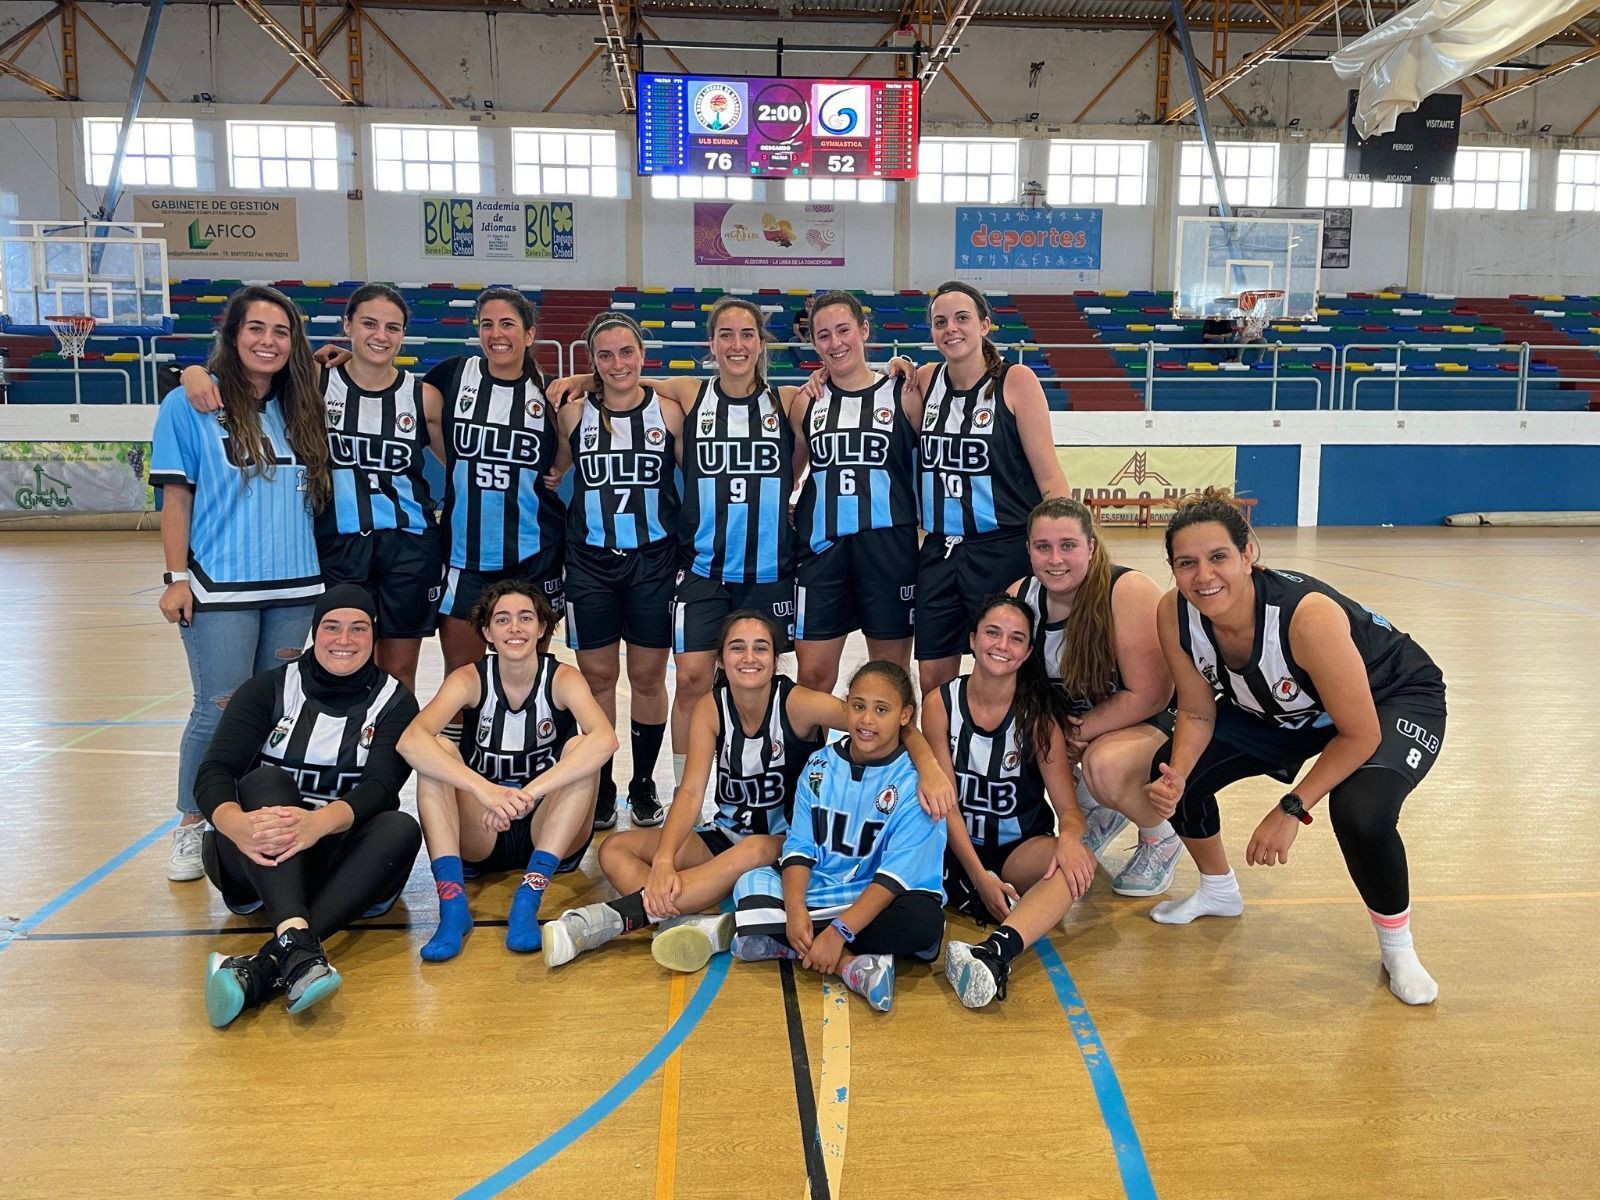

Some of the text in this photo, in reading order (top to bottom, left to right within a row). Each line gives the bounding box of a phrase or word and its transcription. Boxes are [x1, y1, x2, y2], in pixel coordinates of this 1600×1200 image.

[758, 104, 801, 122] 2:00
[1425, 119, 1455, 129] VISITANTE
[820, 140, 863, 148] GYMNASTICA
[1392, 143, 1414, 151] PERIODO
[704, 152, 733, 170] 76
[828, 155, 855, 173] 52
[1348, 173, 1370, 181] FALTAS
[1385, 174, 1412, 182] JUGADOR
[1430, 176, 1451, 184] FALTAS
[152, 200, 279, 211] GABINETE DE GESTIÓN
[476, 201, 521, 211] Academia
[424, 201, 451, 245] BC
[481, 222, 517, 232] Idiomas
[493, 213, 504, 222] de
[525, 204, 551, 248] BC
[970, 224, 1087, 253] deportes
[454, 242, 473, 256] School
[553, 244, 573, 258] School
[328, 432, 412, 473] ULB
[453, 422, 541, 465] ULB
[810, 431, 890, 467] ULB
[696, 441, 781, 475] ULB
[920, 435, 990, 473] ULB
[475, 462, 511, 489] 55
[580, 453, 662, 487] ULB
[730, 477, 747, 503] 9
[839, 468, 856, 496] 6
[939, 472, 963, 498] 10
[614, 488, 631, 514] 7
[544, 577, 562, 594] UL
[772, 600, 795, 617] UL
[1396, 717, 1440, 754] ULB
[1405, 747, 1422, 769] 8
[963, 811, 986, 839] 11
